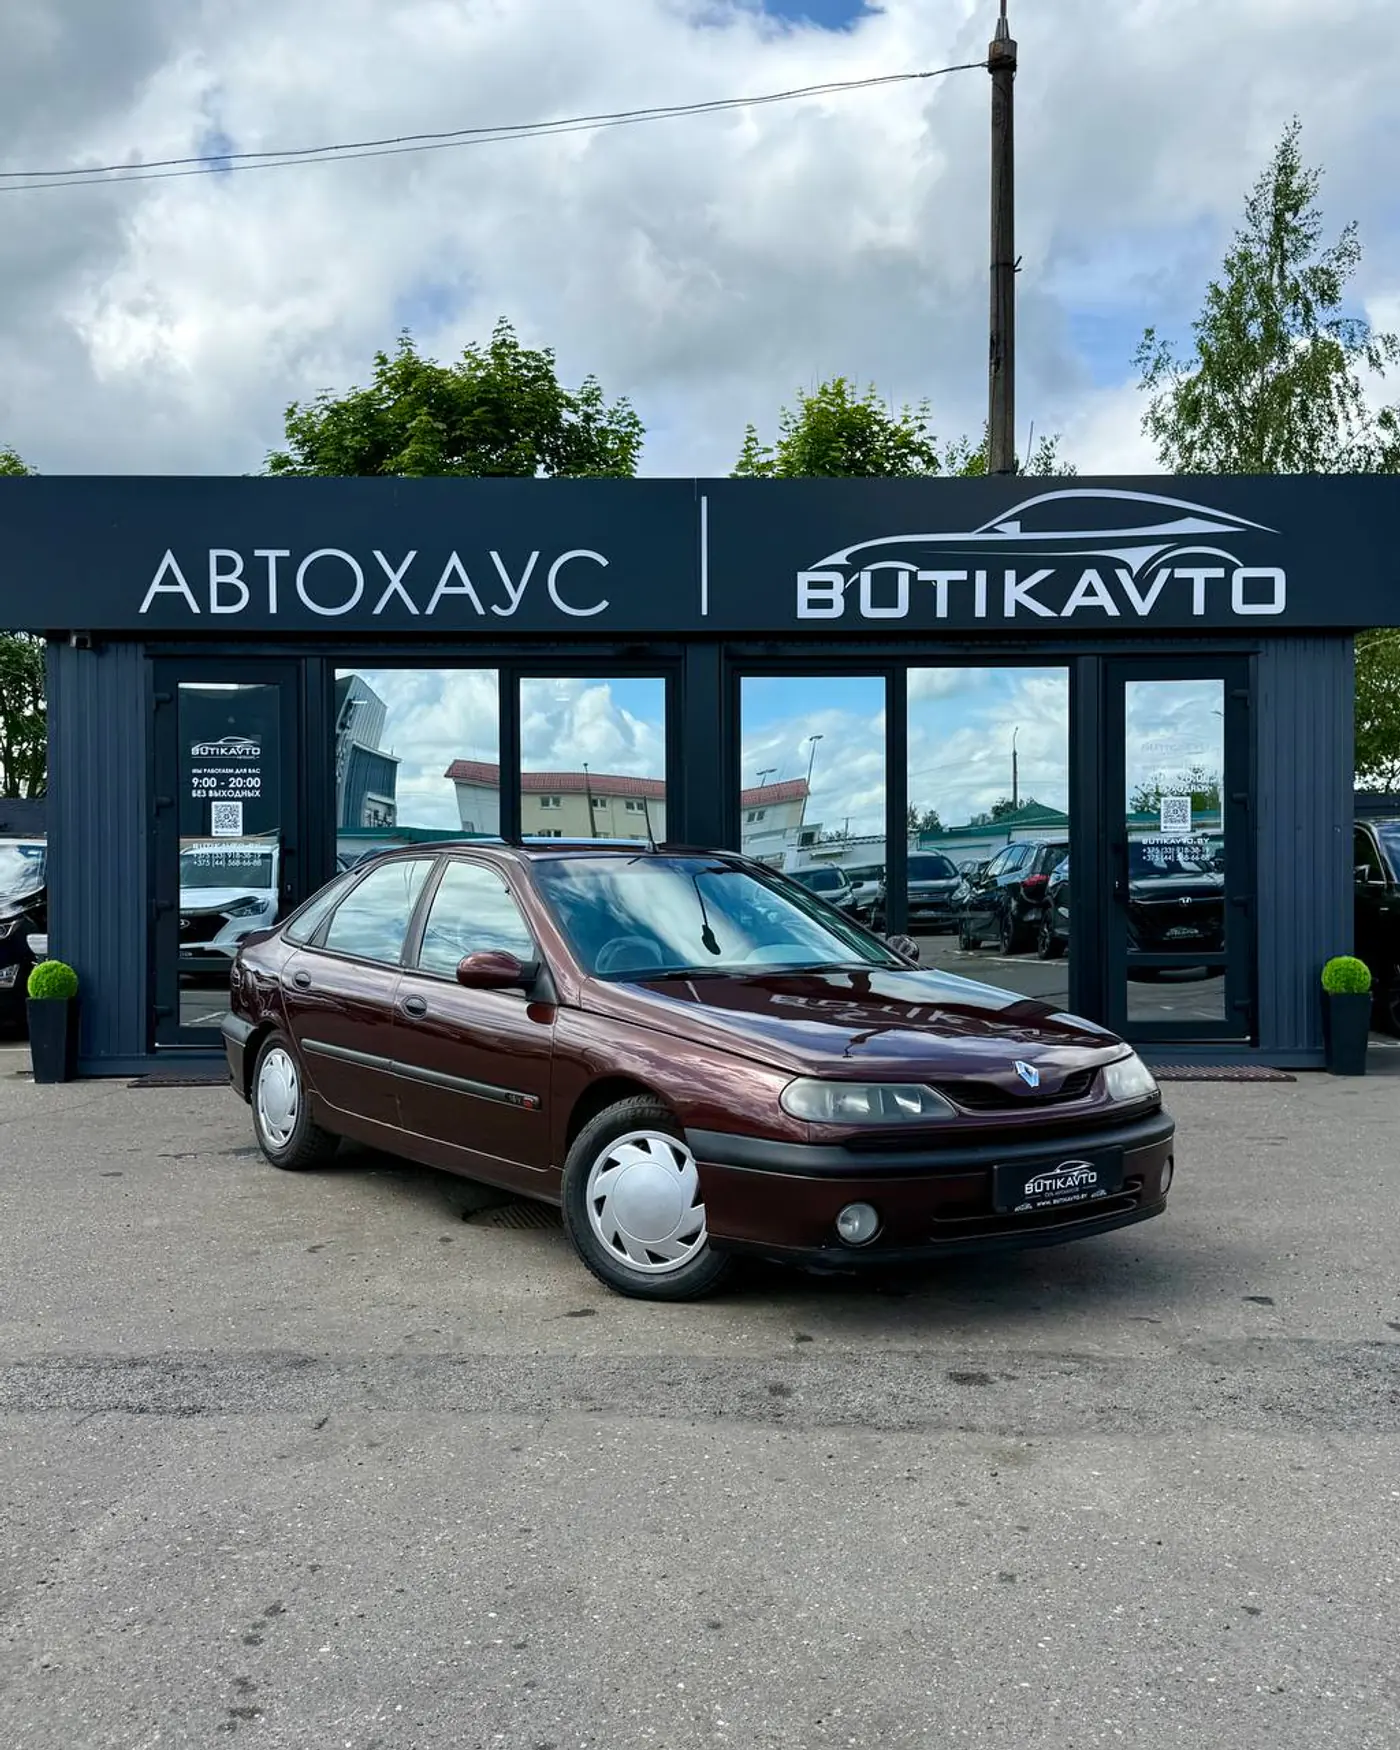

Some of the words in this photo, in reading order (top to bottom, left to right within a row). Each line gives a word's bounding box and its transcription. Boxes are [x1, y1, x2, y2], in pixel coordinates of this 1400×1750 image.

[139, 548, 611, 617] АВТОХАУС
[796, 566, 1287, 620] BUTIKAVTO
[191, 747, 261, 756] BUTIKAVTO
[191, 777, 217, 788] 9:00
[228, 777, 262, 788] 20:00
[191, 789, 207, 798] БЕЗ
[208, 789, 261, 799] ВЫХОДНЫХ
[1024, 1171, 1098, 1195] BUTIKAVTO
